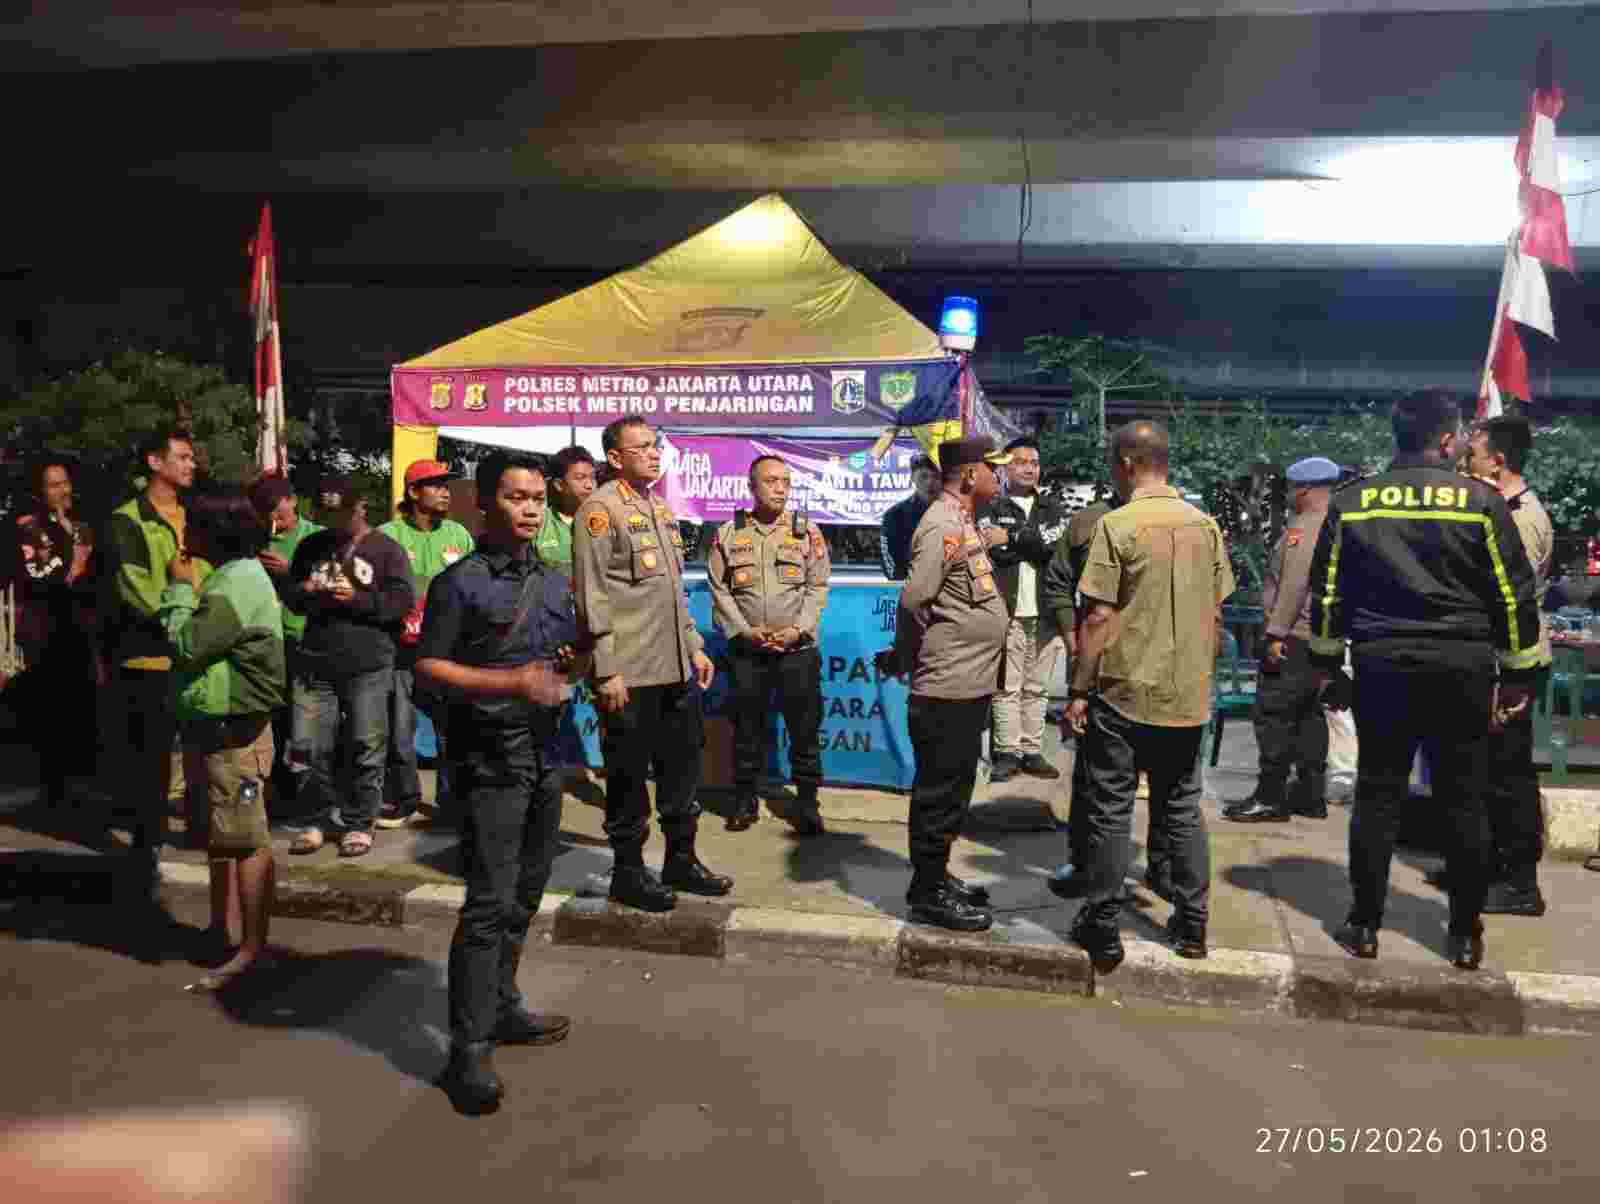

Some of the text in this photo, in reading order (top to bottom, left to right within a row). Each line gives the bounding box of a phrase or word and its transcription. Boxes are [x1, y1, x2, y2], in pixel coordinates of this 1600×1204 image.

[504, 376, 576, 392] POLRES
[582, 376, 649, 392] METRO
[656, 375, 741, 392] JAKARTA
[748, 374, 814, 391] UTARA
[504, 396, 813, 413] POLSEK METRO PENJARINGAN
[680, 474, 753, 499] JAKARTA
[821, 472, 864, 489] ANTI
[870, 472, 912, 489] TAW
[1360, 485, 1468, 508] POLISI
[872, 598, 897, 616] JAG
